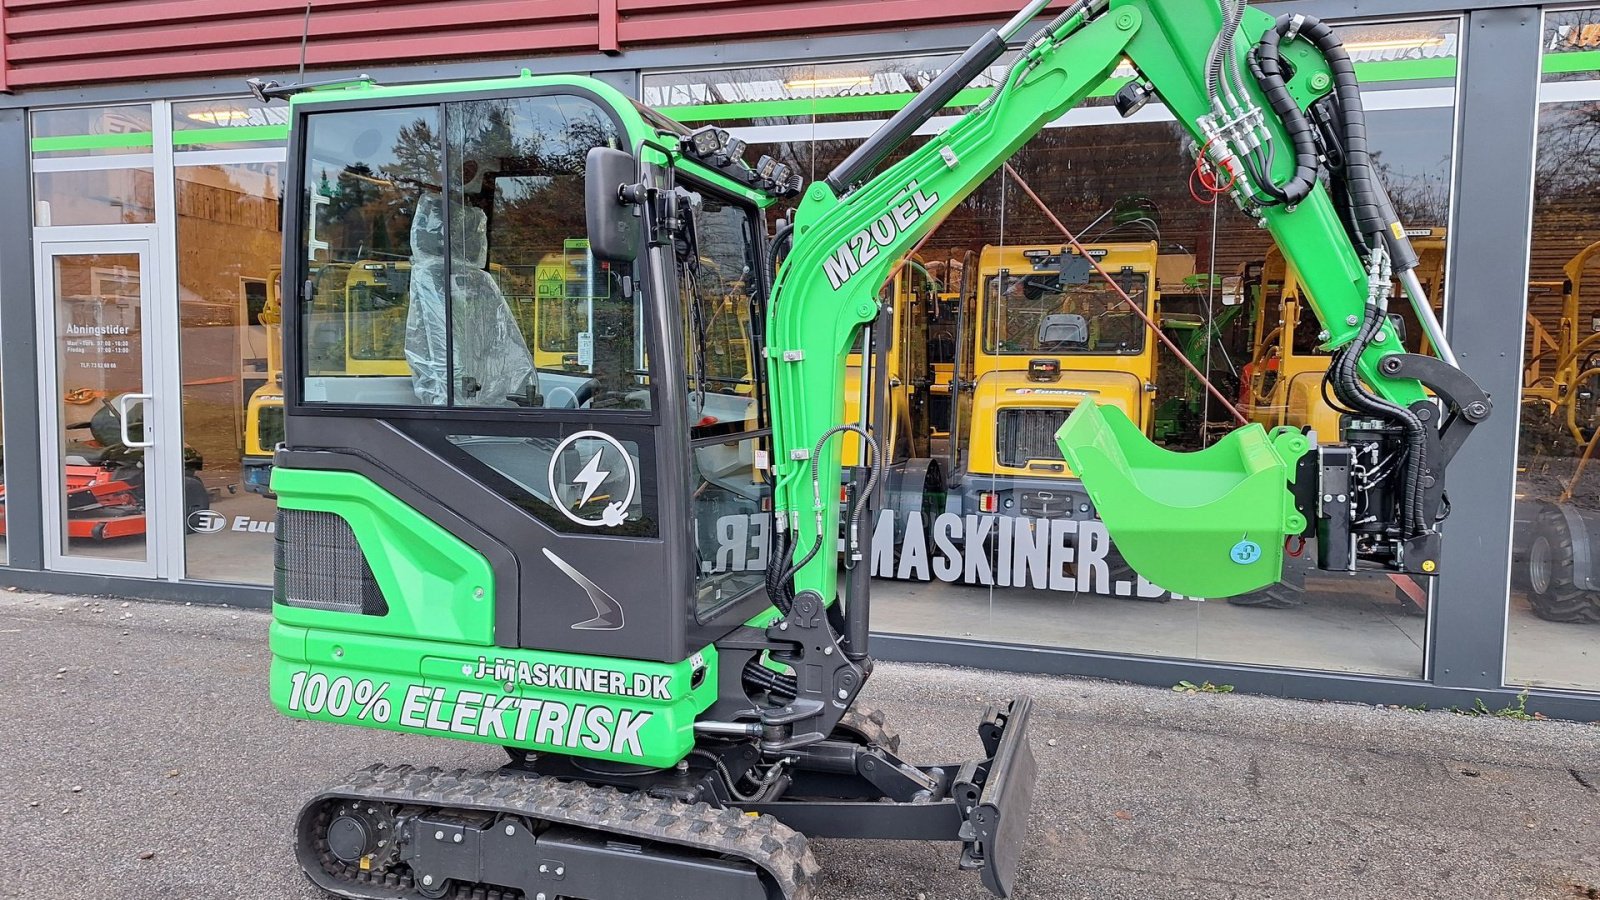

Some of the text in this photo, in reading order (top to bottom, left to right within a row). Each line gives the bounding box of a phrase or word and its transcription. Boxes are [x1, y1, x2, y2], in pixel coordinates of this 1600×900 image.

[822, 179, 940, 291] M20EL
[288, 671, 653, 757] 100% ELEKTRISK
